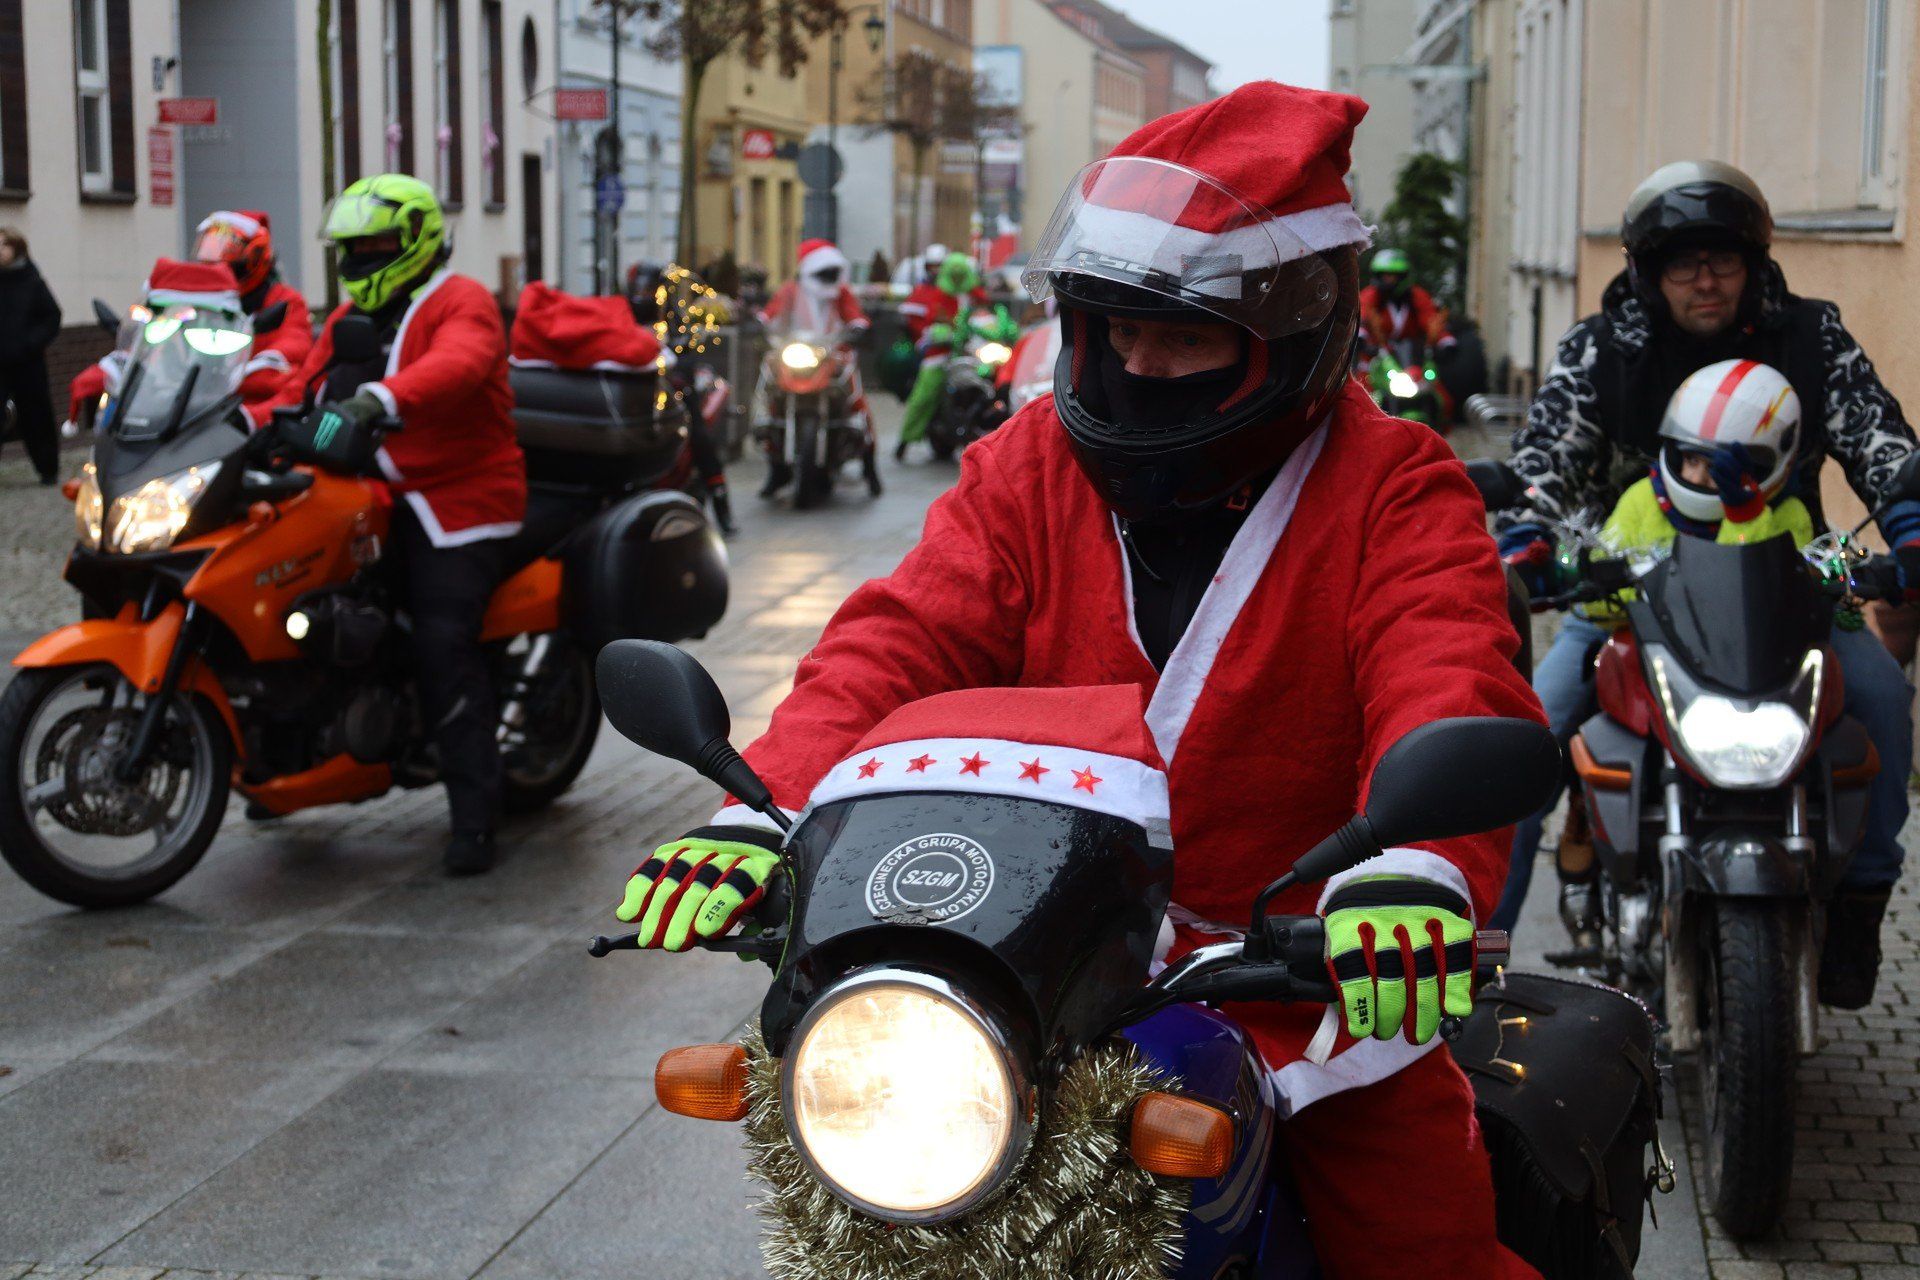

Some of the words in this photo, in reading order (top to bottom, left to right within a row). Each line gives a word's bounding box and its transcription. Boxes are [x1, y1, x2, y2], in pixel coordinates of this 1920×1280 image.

[918, 837, 968, 852] GRUPA
[901, 869, 960, 888] SZGM
[932, 847, 988, 917] MOTOCYKLOW
